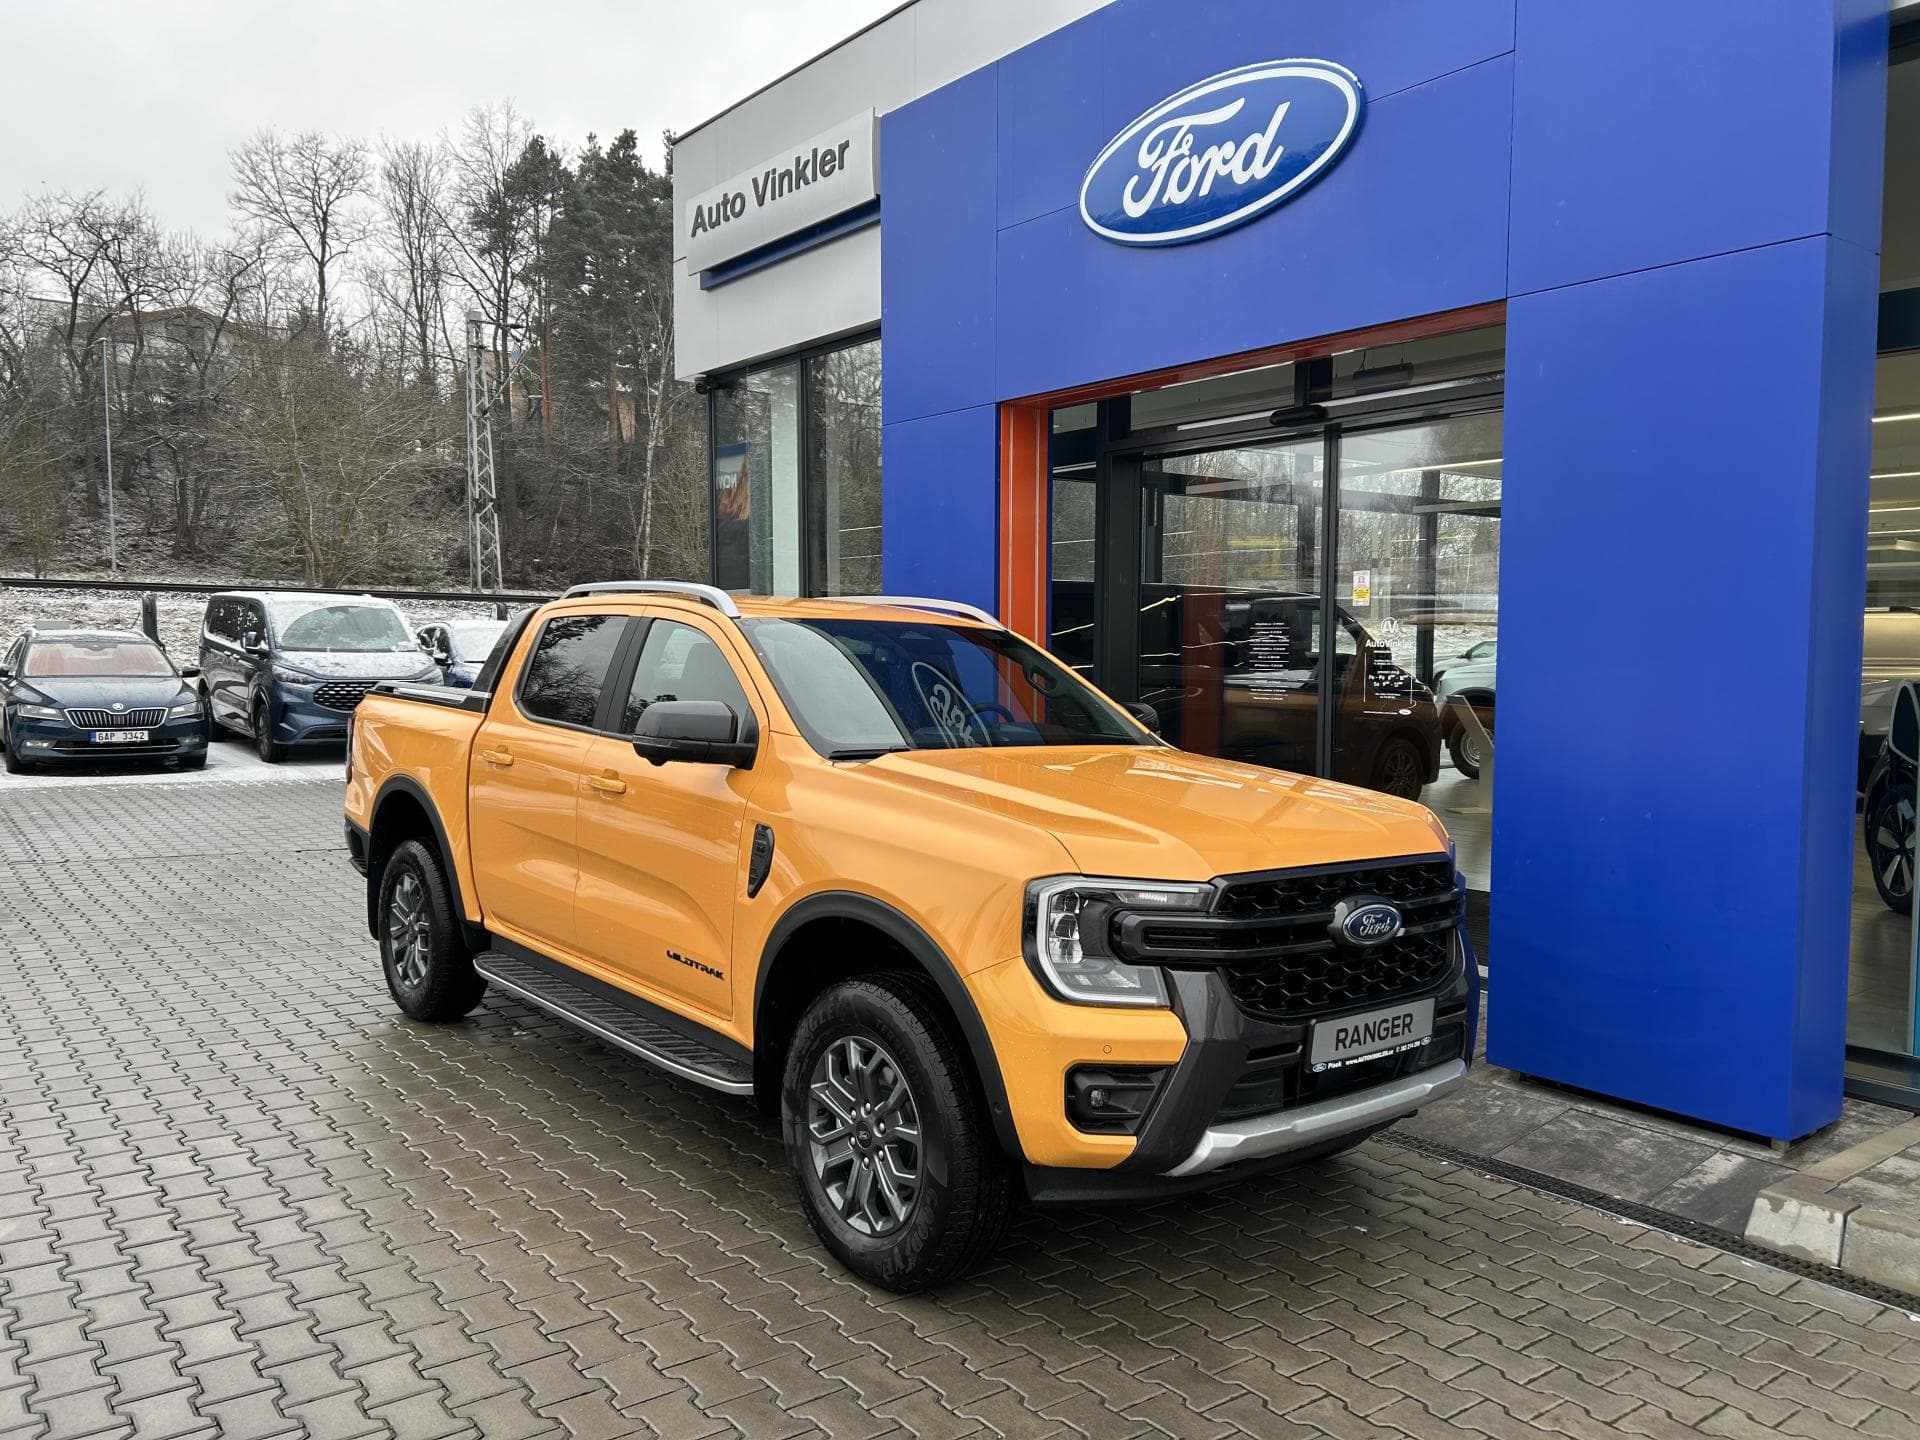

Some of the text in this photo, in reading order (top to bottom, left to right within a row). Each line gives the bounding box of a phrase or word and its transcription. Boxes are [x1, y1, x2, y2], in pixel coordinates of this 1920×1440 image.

[1122, 97, 1291, 218] Ford
[690, 139, 850, 238] Auto Vinkler
[97, 731, 145, 741] 6AP 3342
[1359, 913, 1391, 937] Ford
[1334, 1012, 1414, 1052] RANGER
